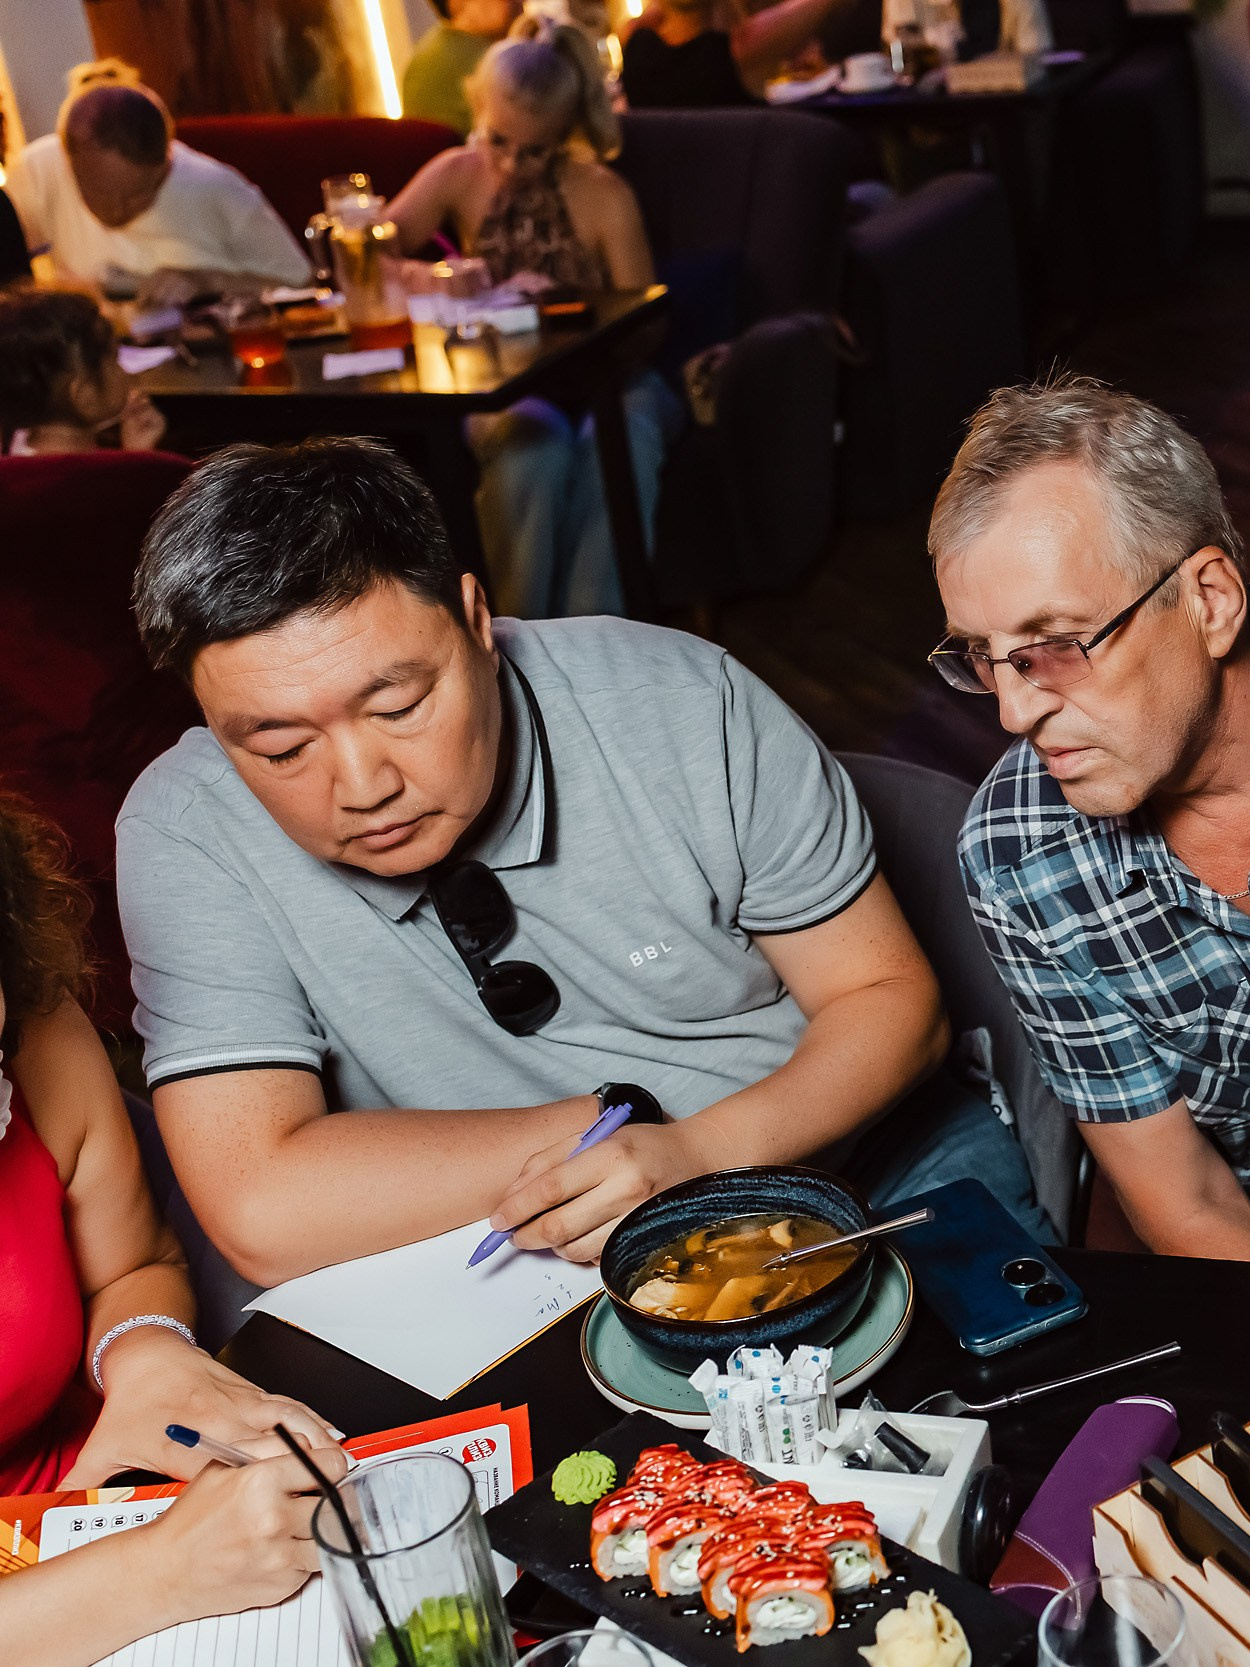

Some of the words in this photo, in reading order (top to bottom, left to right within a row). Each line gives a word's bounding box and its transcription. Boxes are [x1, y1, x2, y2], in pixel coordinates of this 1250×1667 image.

[628, 941, 673, 968] BBL
[94, 1518, 104, 1528] 19
[115, 1516, 124, 1525] 18
[135, 1514, 144, 1522] 17
[73, 1520, 83, 1532] 20
